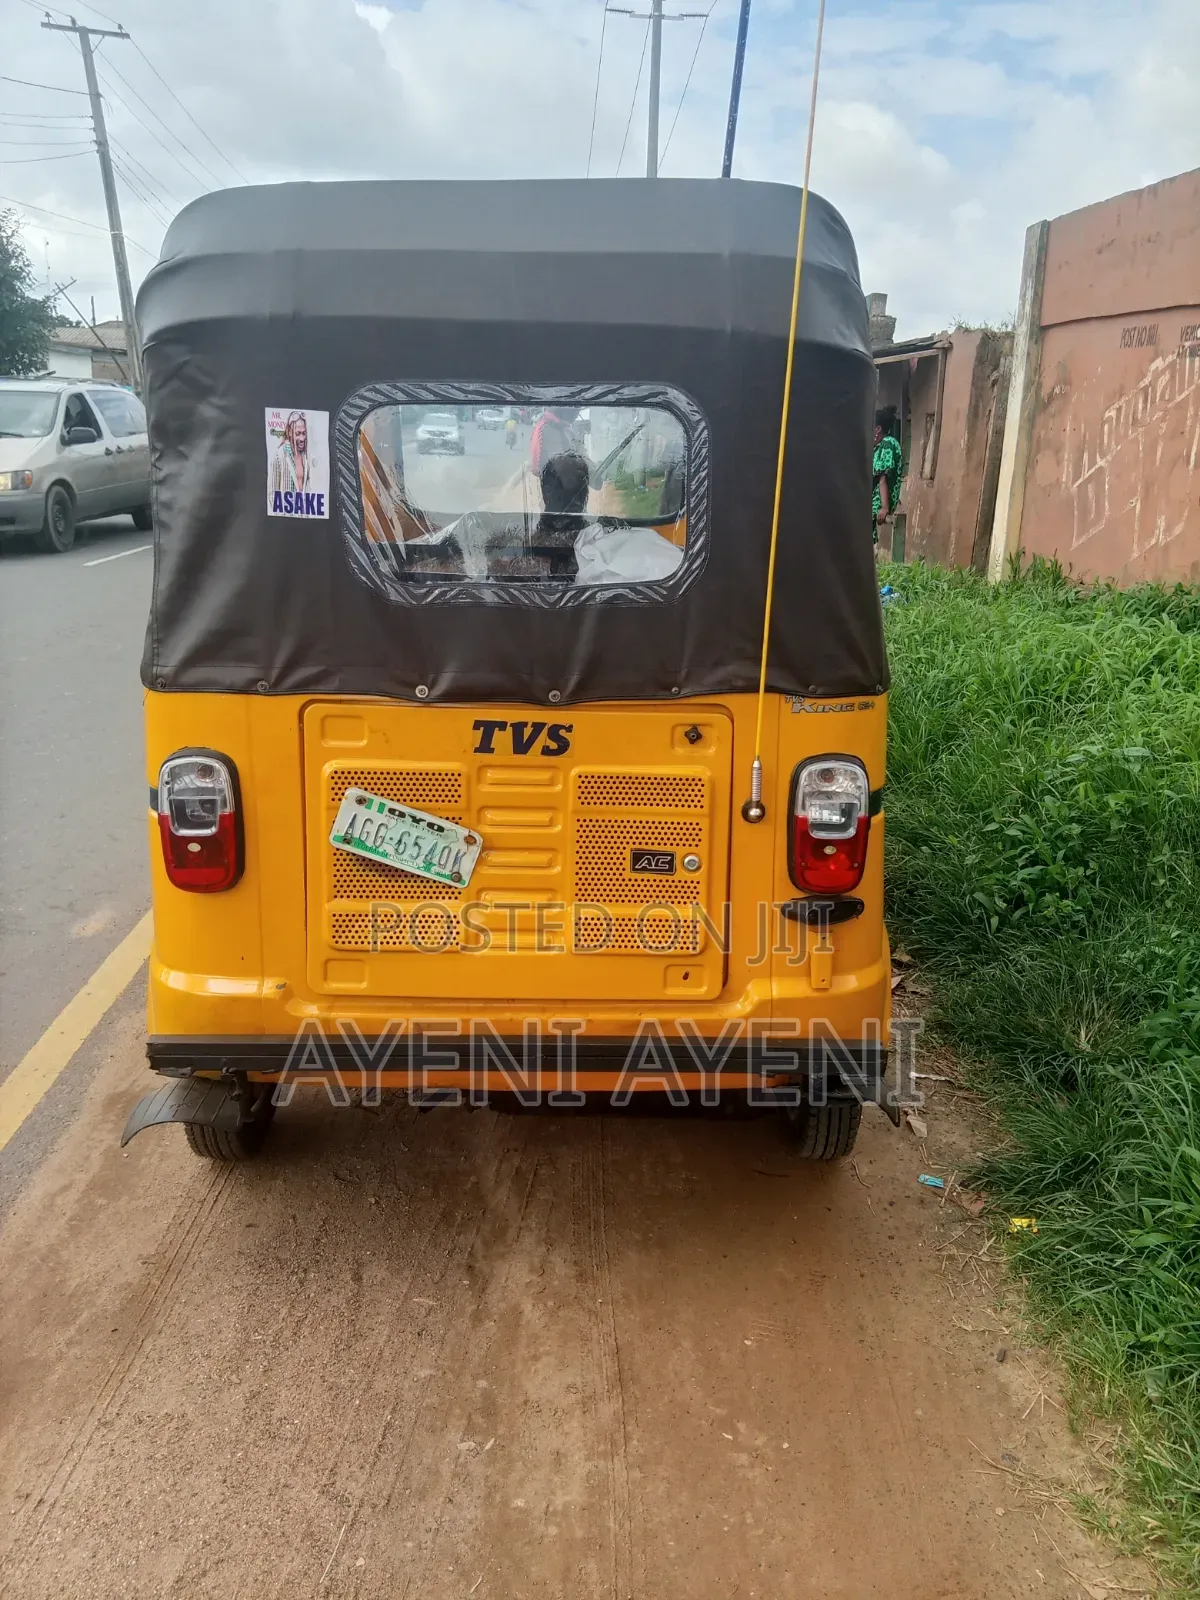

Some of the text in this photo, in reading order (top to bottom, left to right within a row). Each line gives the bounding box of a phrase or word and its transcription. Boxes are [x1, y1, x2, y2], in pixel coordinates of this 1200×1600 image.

[273, 490, 325, 516] ASAKE
[472, 719, 573, 756] TVS
[387, 807, 446, 833] OYO
[634, 855, 672, 870] AC
